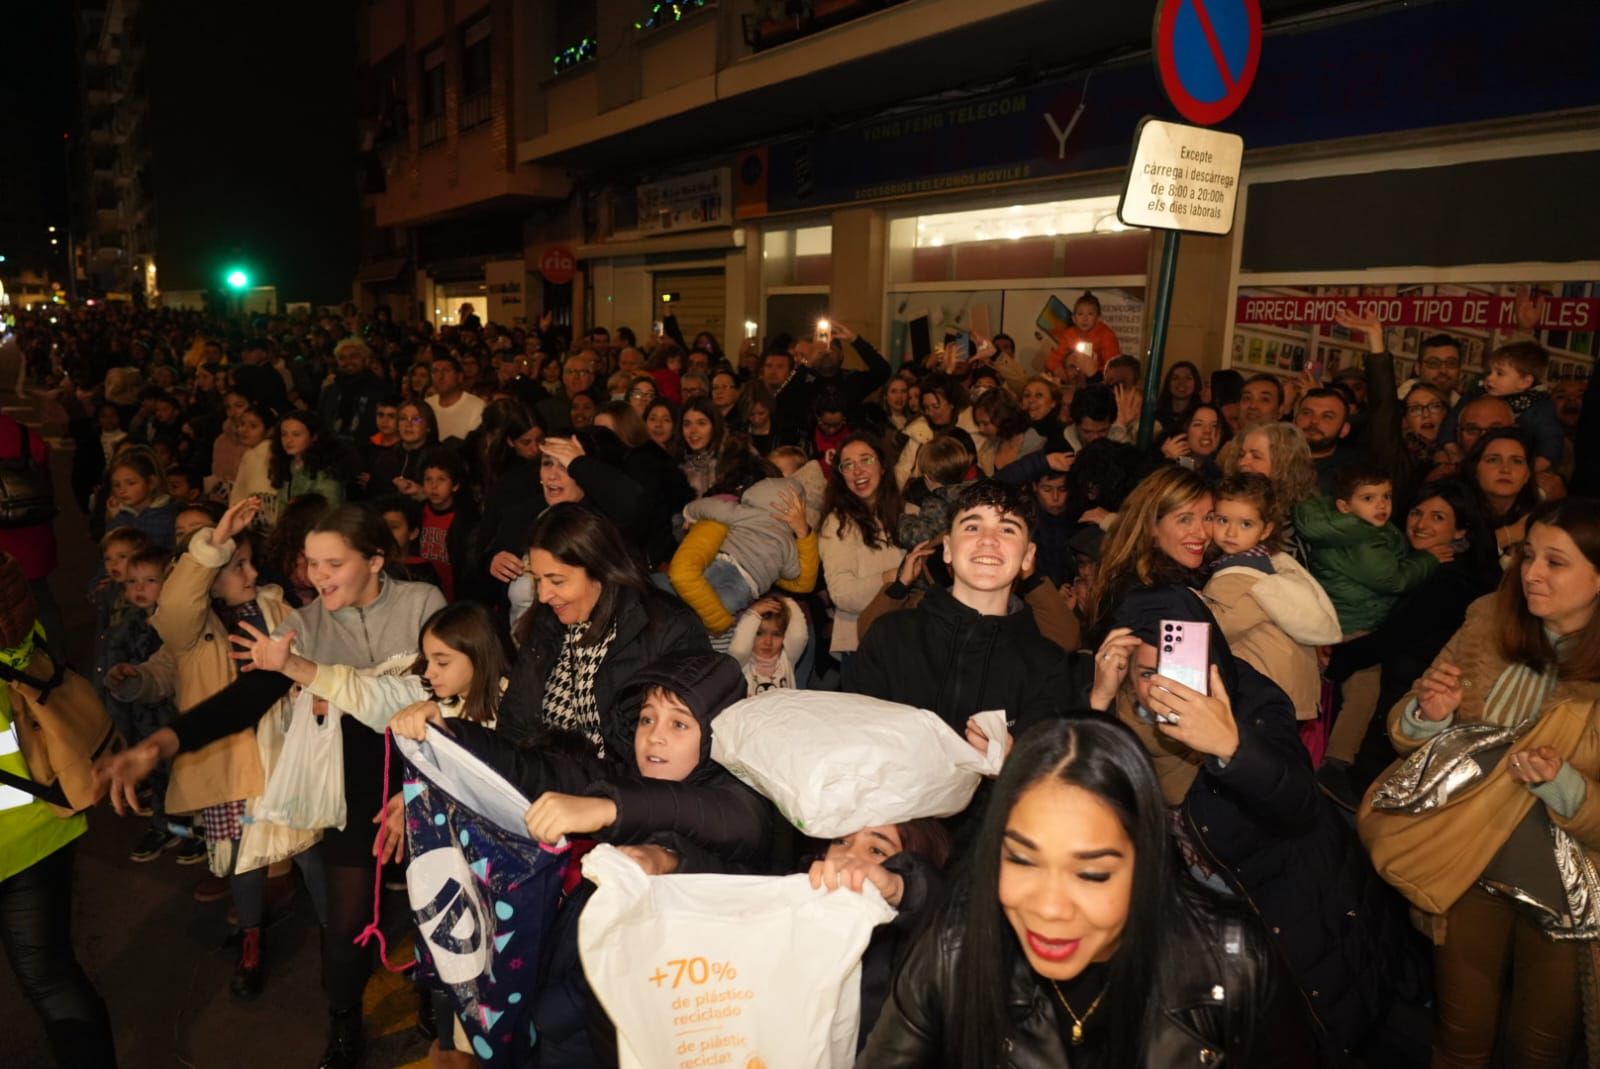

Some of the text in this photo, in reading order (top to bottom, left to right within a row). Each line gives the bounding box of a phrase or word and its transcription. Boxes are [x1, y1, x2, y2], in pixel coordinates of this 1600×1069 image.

[903, 115, 945, 134] FENG
[950, 97, 1027, 126] TELECOM
[1180, 146, 1214, 163] Excepte
[1143, 162, 1183, 180] càrrega
[1150, 182, 1224, 203] de 8:00 a 20:00h
[1147, 200, 1221, 219] els dies laborals
[545, 251, 573, 271] ria
[1245, 300, 1347, 321] ARREGLAMOS
[1413, 300, 1453, 323] TIPO
[1462, 301, 1489, 324] DE
[1499, 302, 1590, 327] MILES
[648, 955, 737, 989] +70%
[671, 990, 754, 1010] de plástico
[674, 1006, 741, 1024] reciclado
[676, 1040, 696, 1055] de
